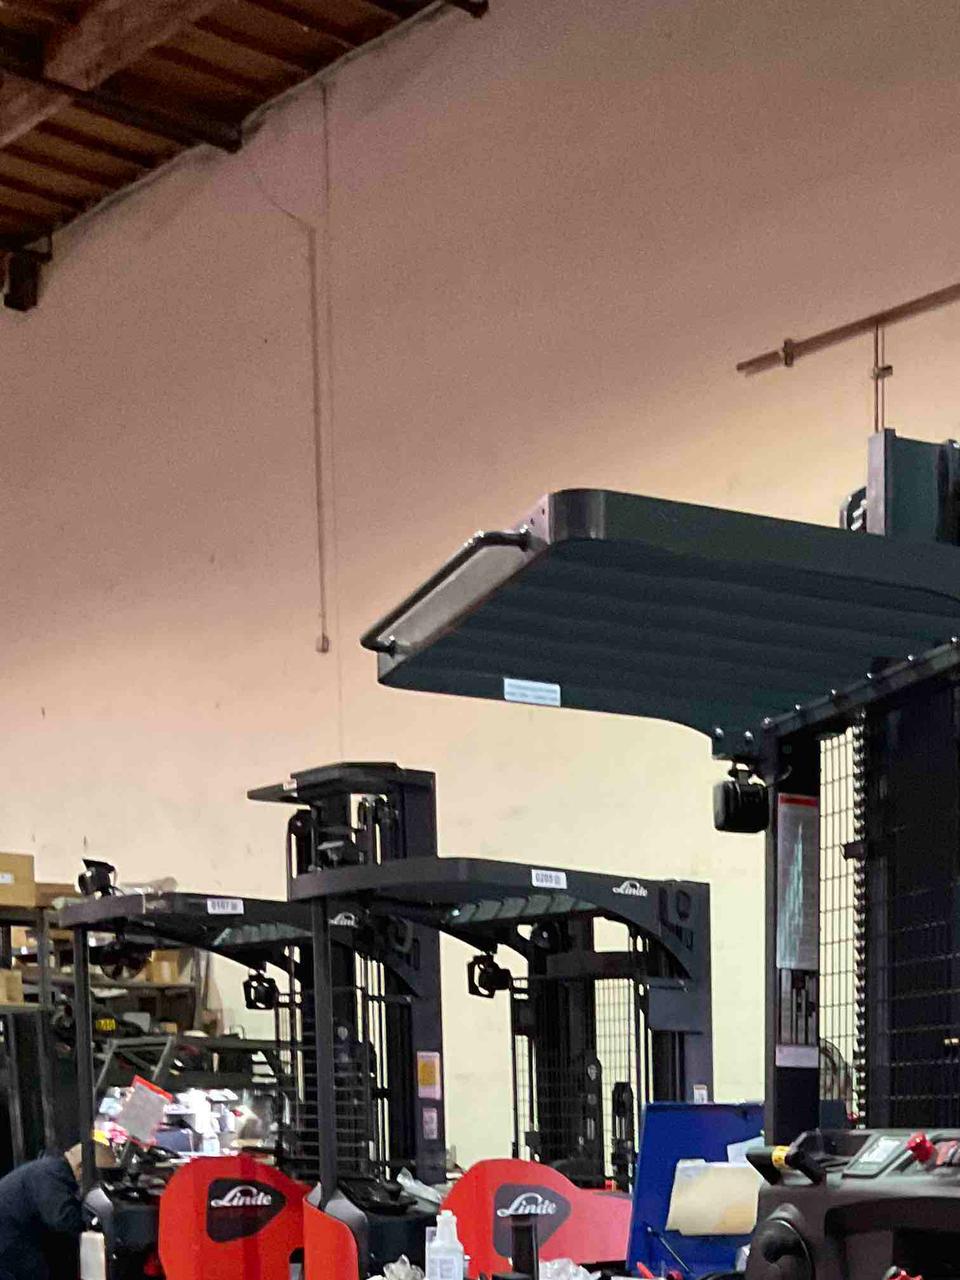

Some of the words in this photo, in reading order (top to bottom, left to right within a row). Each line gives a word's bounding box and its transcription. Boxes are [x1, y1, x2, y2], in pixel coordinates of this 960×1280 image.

[612, 880, 648, 897] Linde
[210, 1185, 272, 1208] Linde
[496, 1192, 557, 1217] Linde
